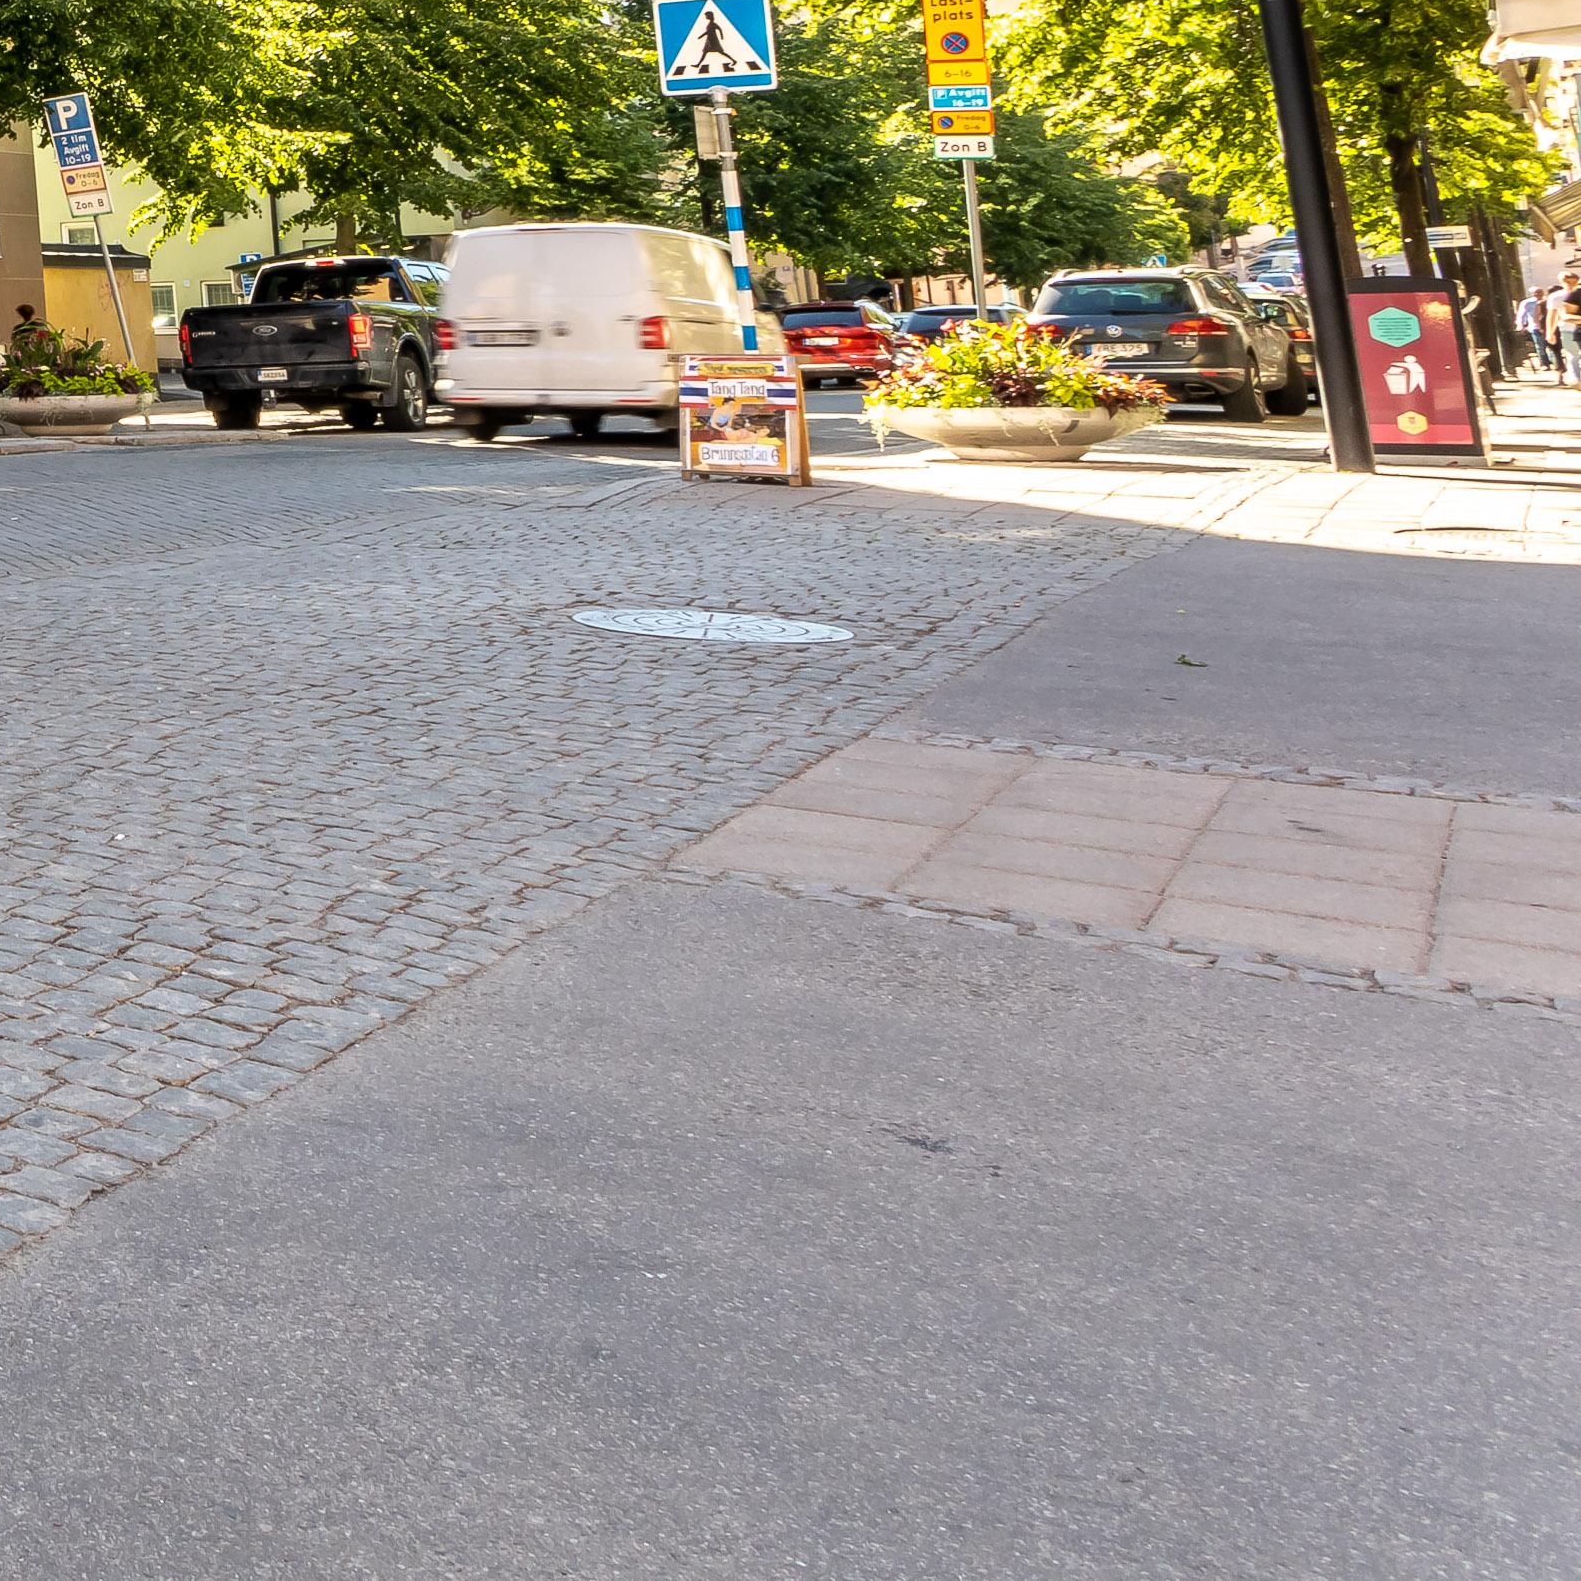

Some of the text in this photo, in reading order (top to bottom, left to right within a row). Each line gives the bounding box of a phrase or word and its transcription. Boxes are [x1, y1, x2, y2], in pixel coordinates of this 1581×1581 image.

[933, 10, 974, 23] plats
[944, 70, 972, 78] 6-16
[949, 88, 986, 99] Avgift
[951, 99, 984, 107] 16-19
[55, 100, 78, 130] P
[61, 134, 86, 145] 2 tim
[63, 143, 90, 156] Avgift
[940, 141, 987, 152] Zon B
[65, 154, 92, 165] 10-19
[76, 171, 99, 180] Fredag
[74, 198, 105, 210] Zon B
[708, 381, 765, 396] Tang Tang
[771, 448, 780, 463] 6
